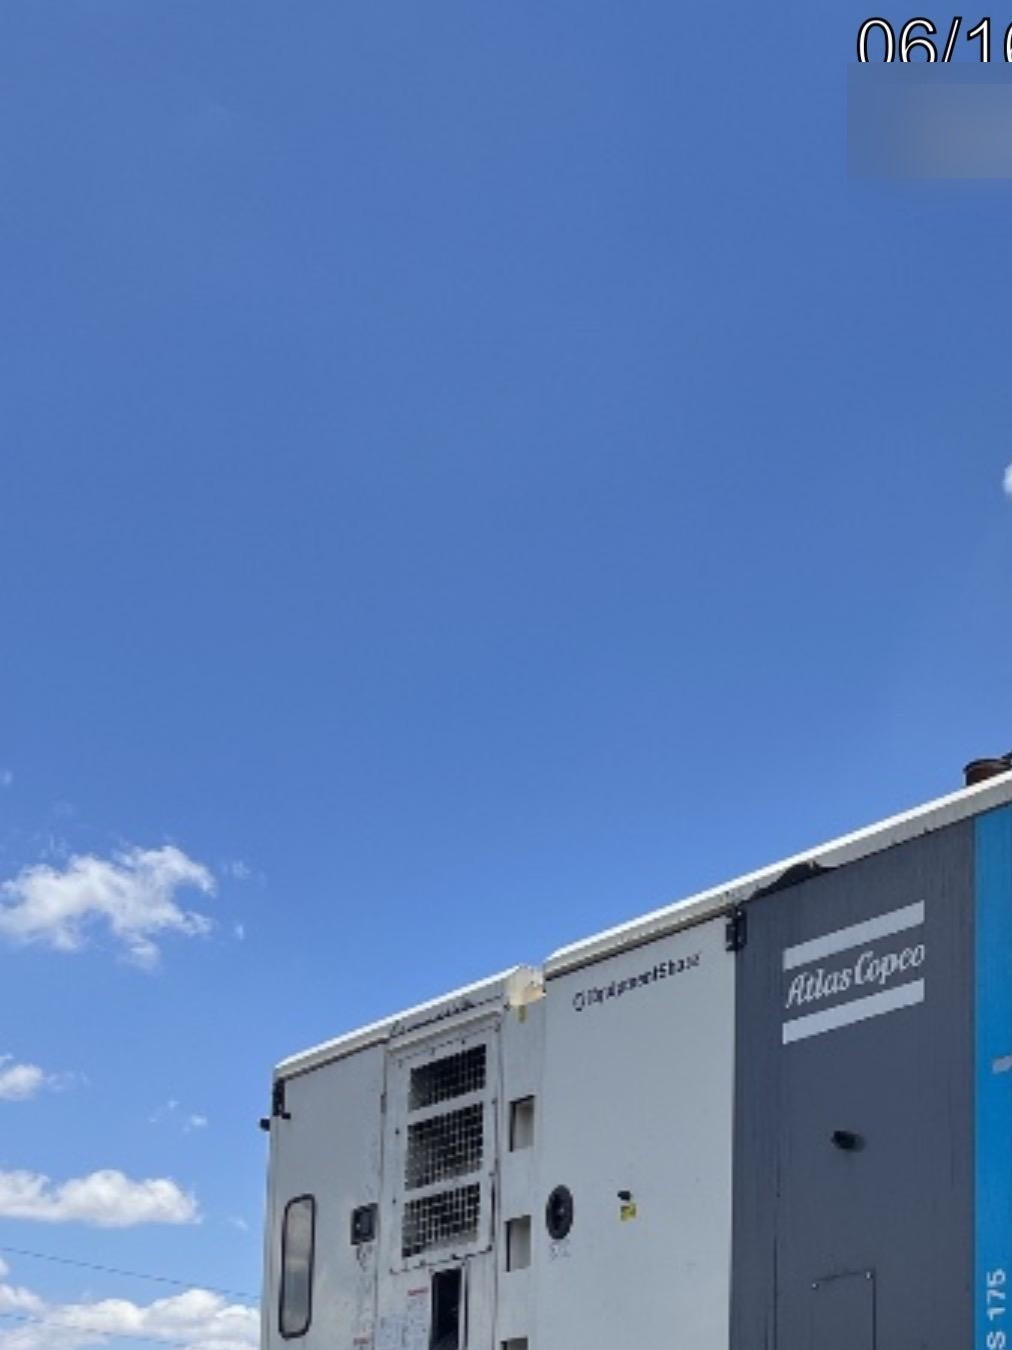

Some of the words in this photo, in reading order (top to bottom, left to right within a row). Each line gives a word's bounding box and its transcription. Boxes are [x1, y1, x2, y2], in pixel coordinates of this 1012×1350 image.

[785, 968, 851, 1009] Atlas
[854, 943, 926, 985] Copco
[986, 1268, 1006, 1321] 175
